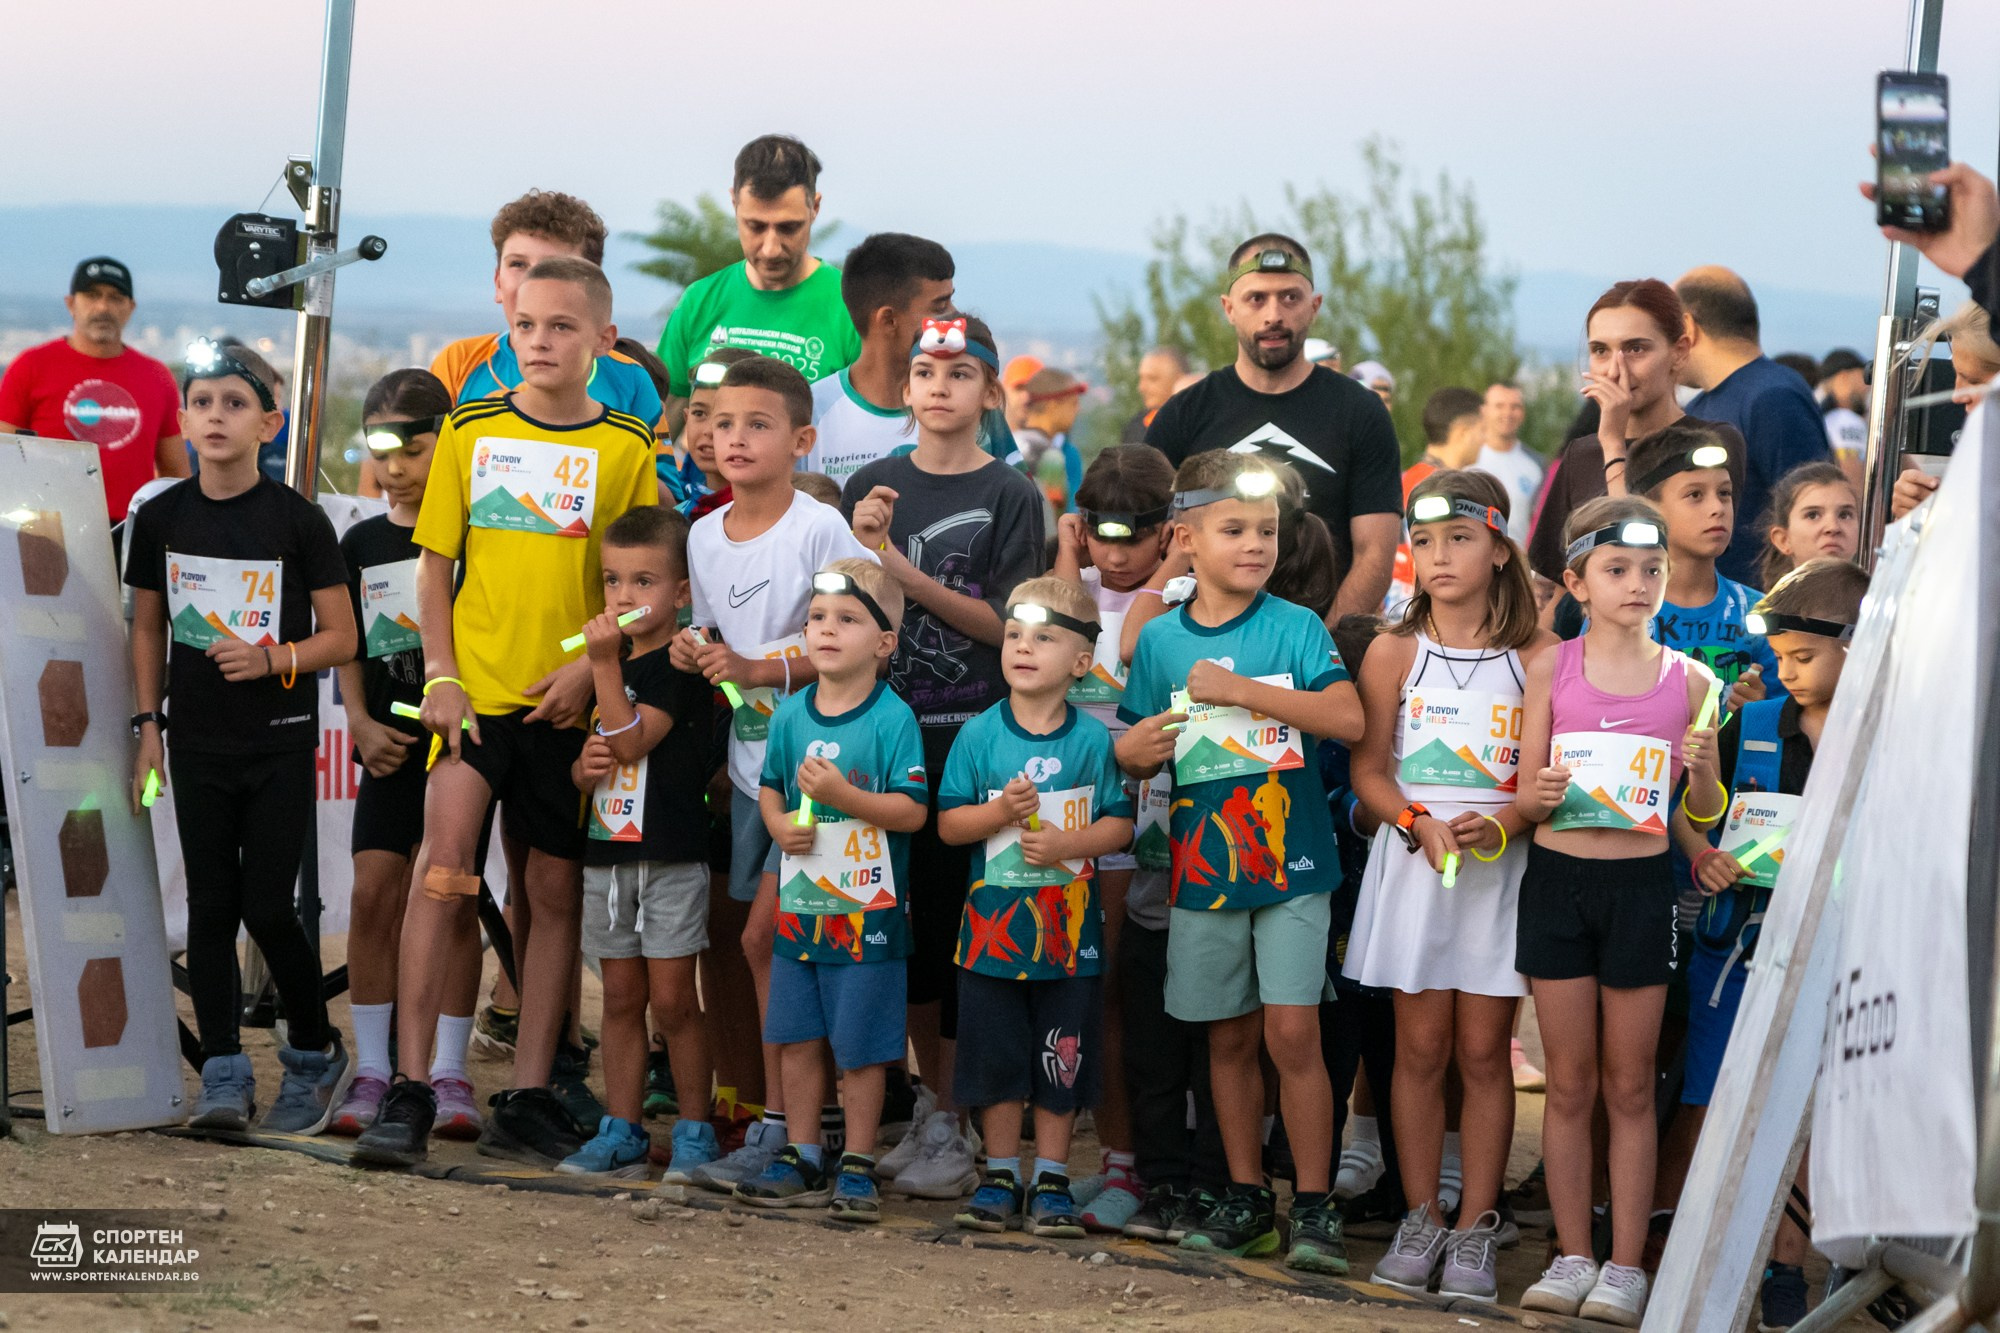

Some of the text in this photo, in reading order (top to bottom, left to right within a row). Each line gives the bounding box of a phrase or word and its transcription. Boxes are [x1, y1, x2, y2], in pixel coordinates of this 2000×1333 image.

[243, 224, 280, 235] VARYTEC
[491, 454, 522, 465] PLOVDIV
[821, 451, 878, 465] Experience
[553, 454, 590, 490] 42
[541, 491, 585, 512] KIDS
[181, 571, 207, 583] PLOVDIV
[241, 570, 275, 604] 74
[228, 609, 271, 628] KIDS
[1425, 714, 1447, 725] HILLS
[1426, 705, 1459, 716] PLOVDIV
[1490, 704, 1524, 741] 50
[1246, 725, 1289, 748] KIDS
[1480, 744, 1520, 766] KIDS
[1563, 749, 1593, 760] PLOVDIV
[1629, 746, 1666, 782] 47
[1616, 784, 1660, 807] KIDS
[600, 798, 634, 816] KIDS
[1064, 796, 1088, 832] 80
[1746, 808, 1778, 819] PLOVDIV
[844, 826, 882, 863] 43
[839, 866, 882, 889] KIDS
